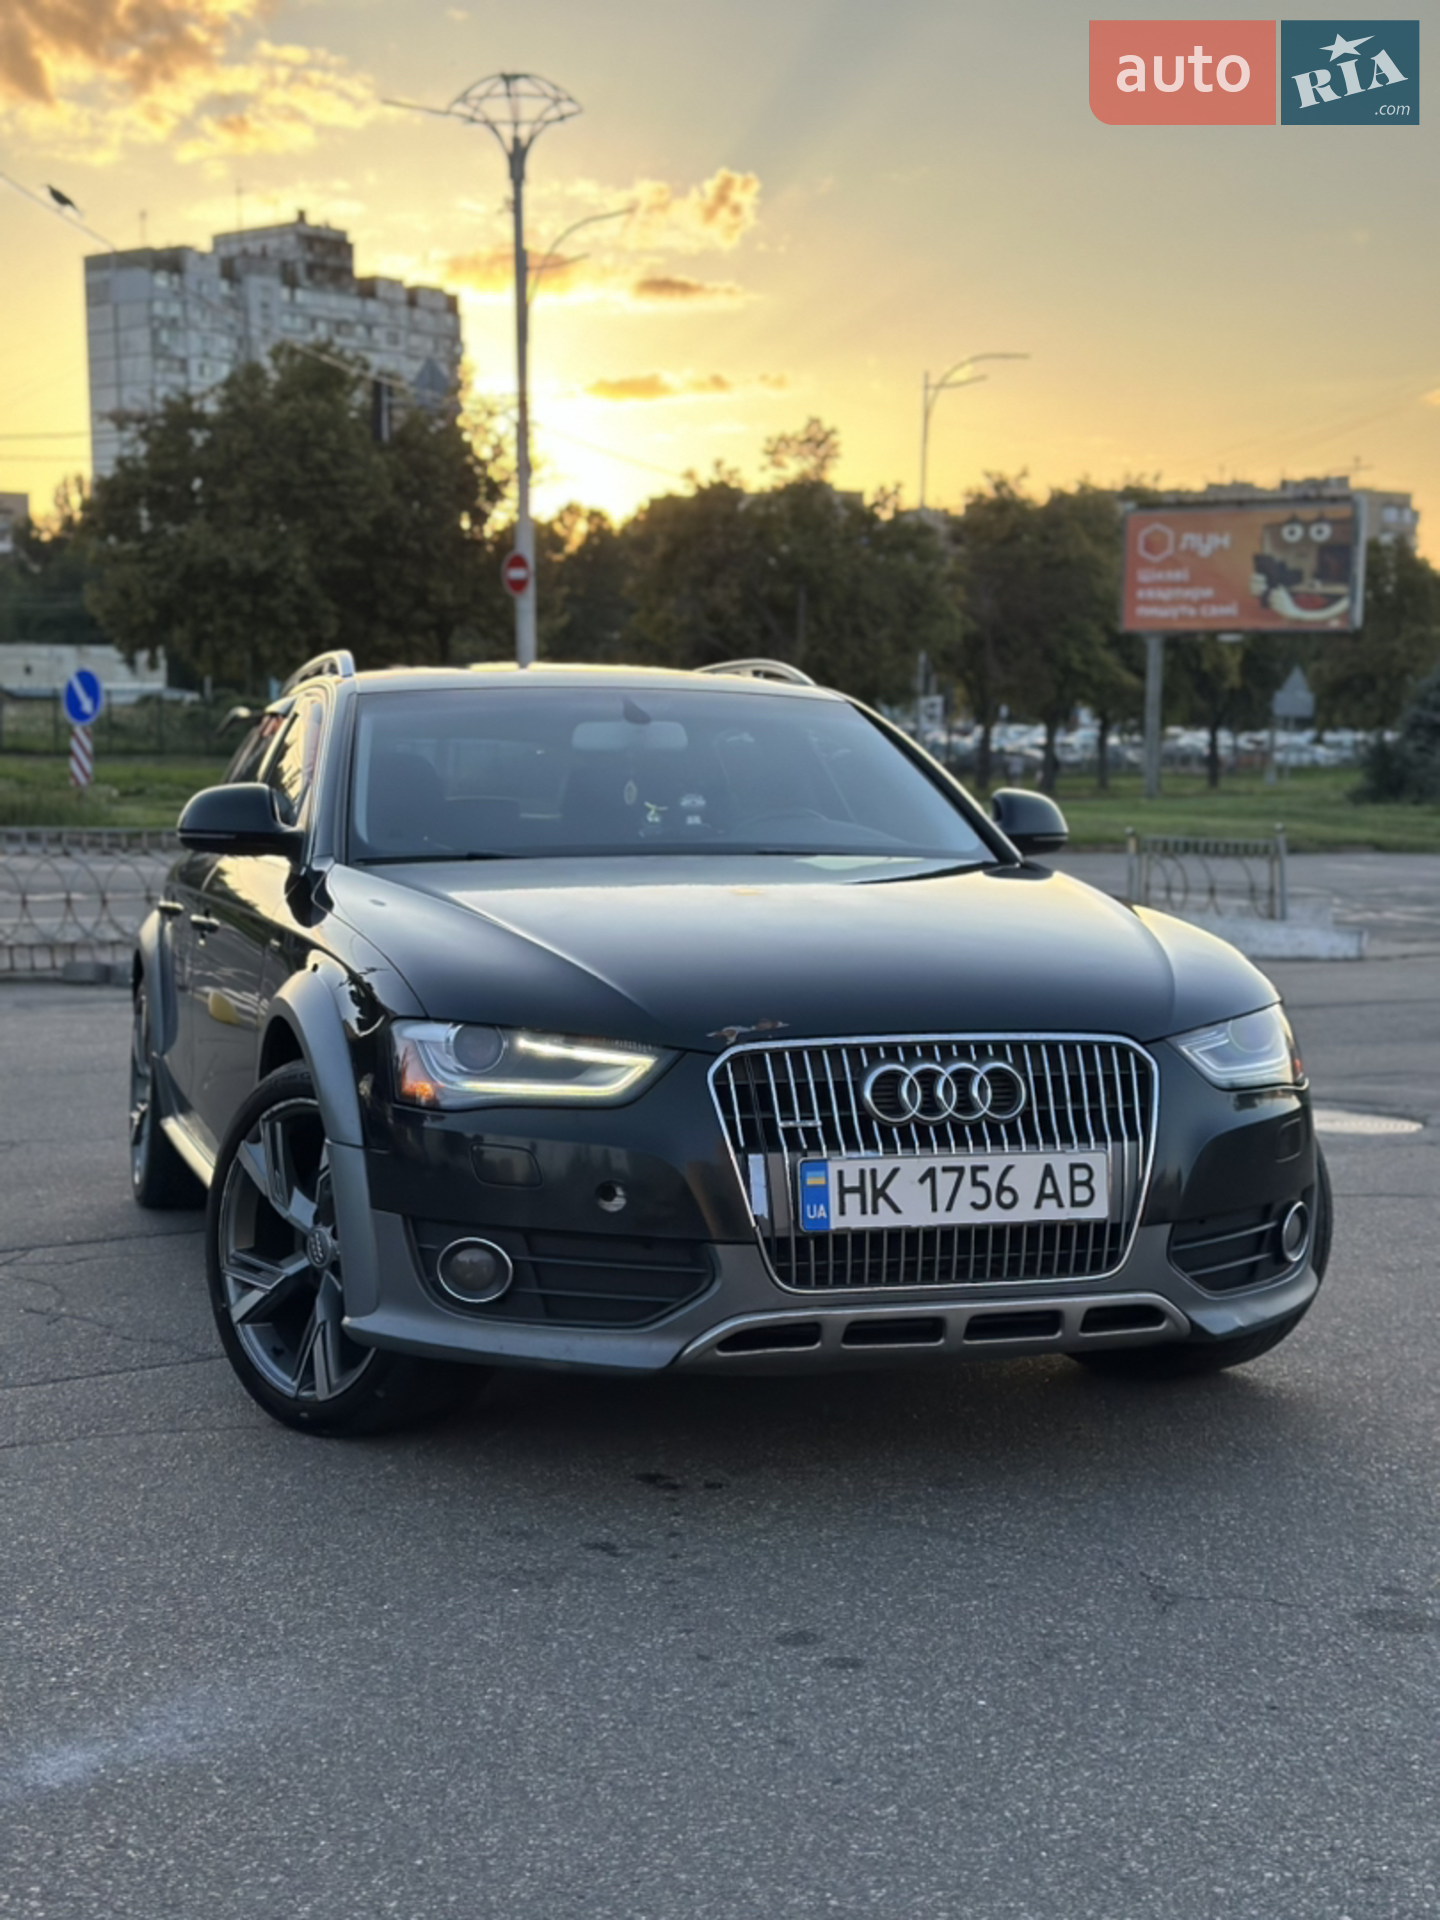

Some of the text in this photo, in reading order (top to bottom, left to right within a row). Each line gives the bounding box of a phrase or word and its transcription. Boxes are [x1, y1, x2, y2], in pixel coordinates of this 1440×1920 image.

[837, 1162, 1095, 1216] HK 1756 AB
[806, 1204, 828, 1220] UA
